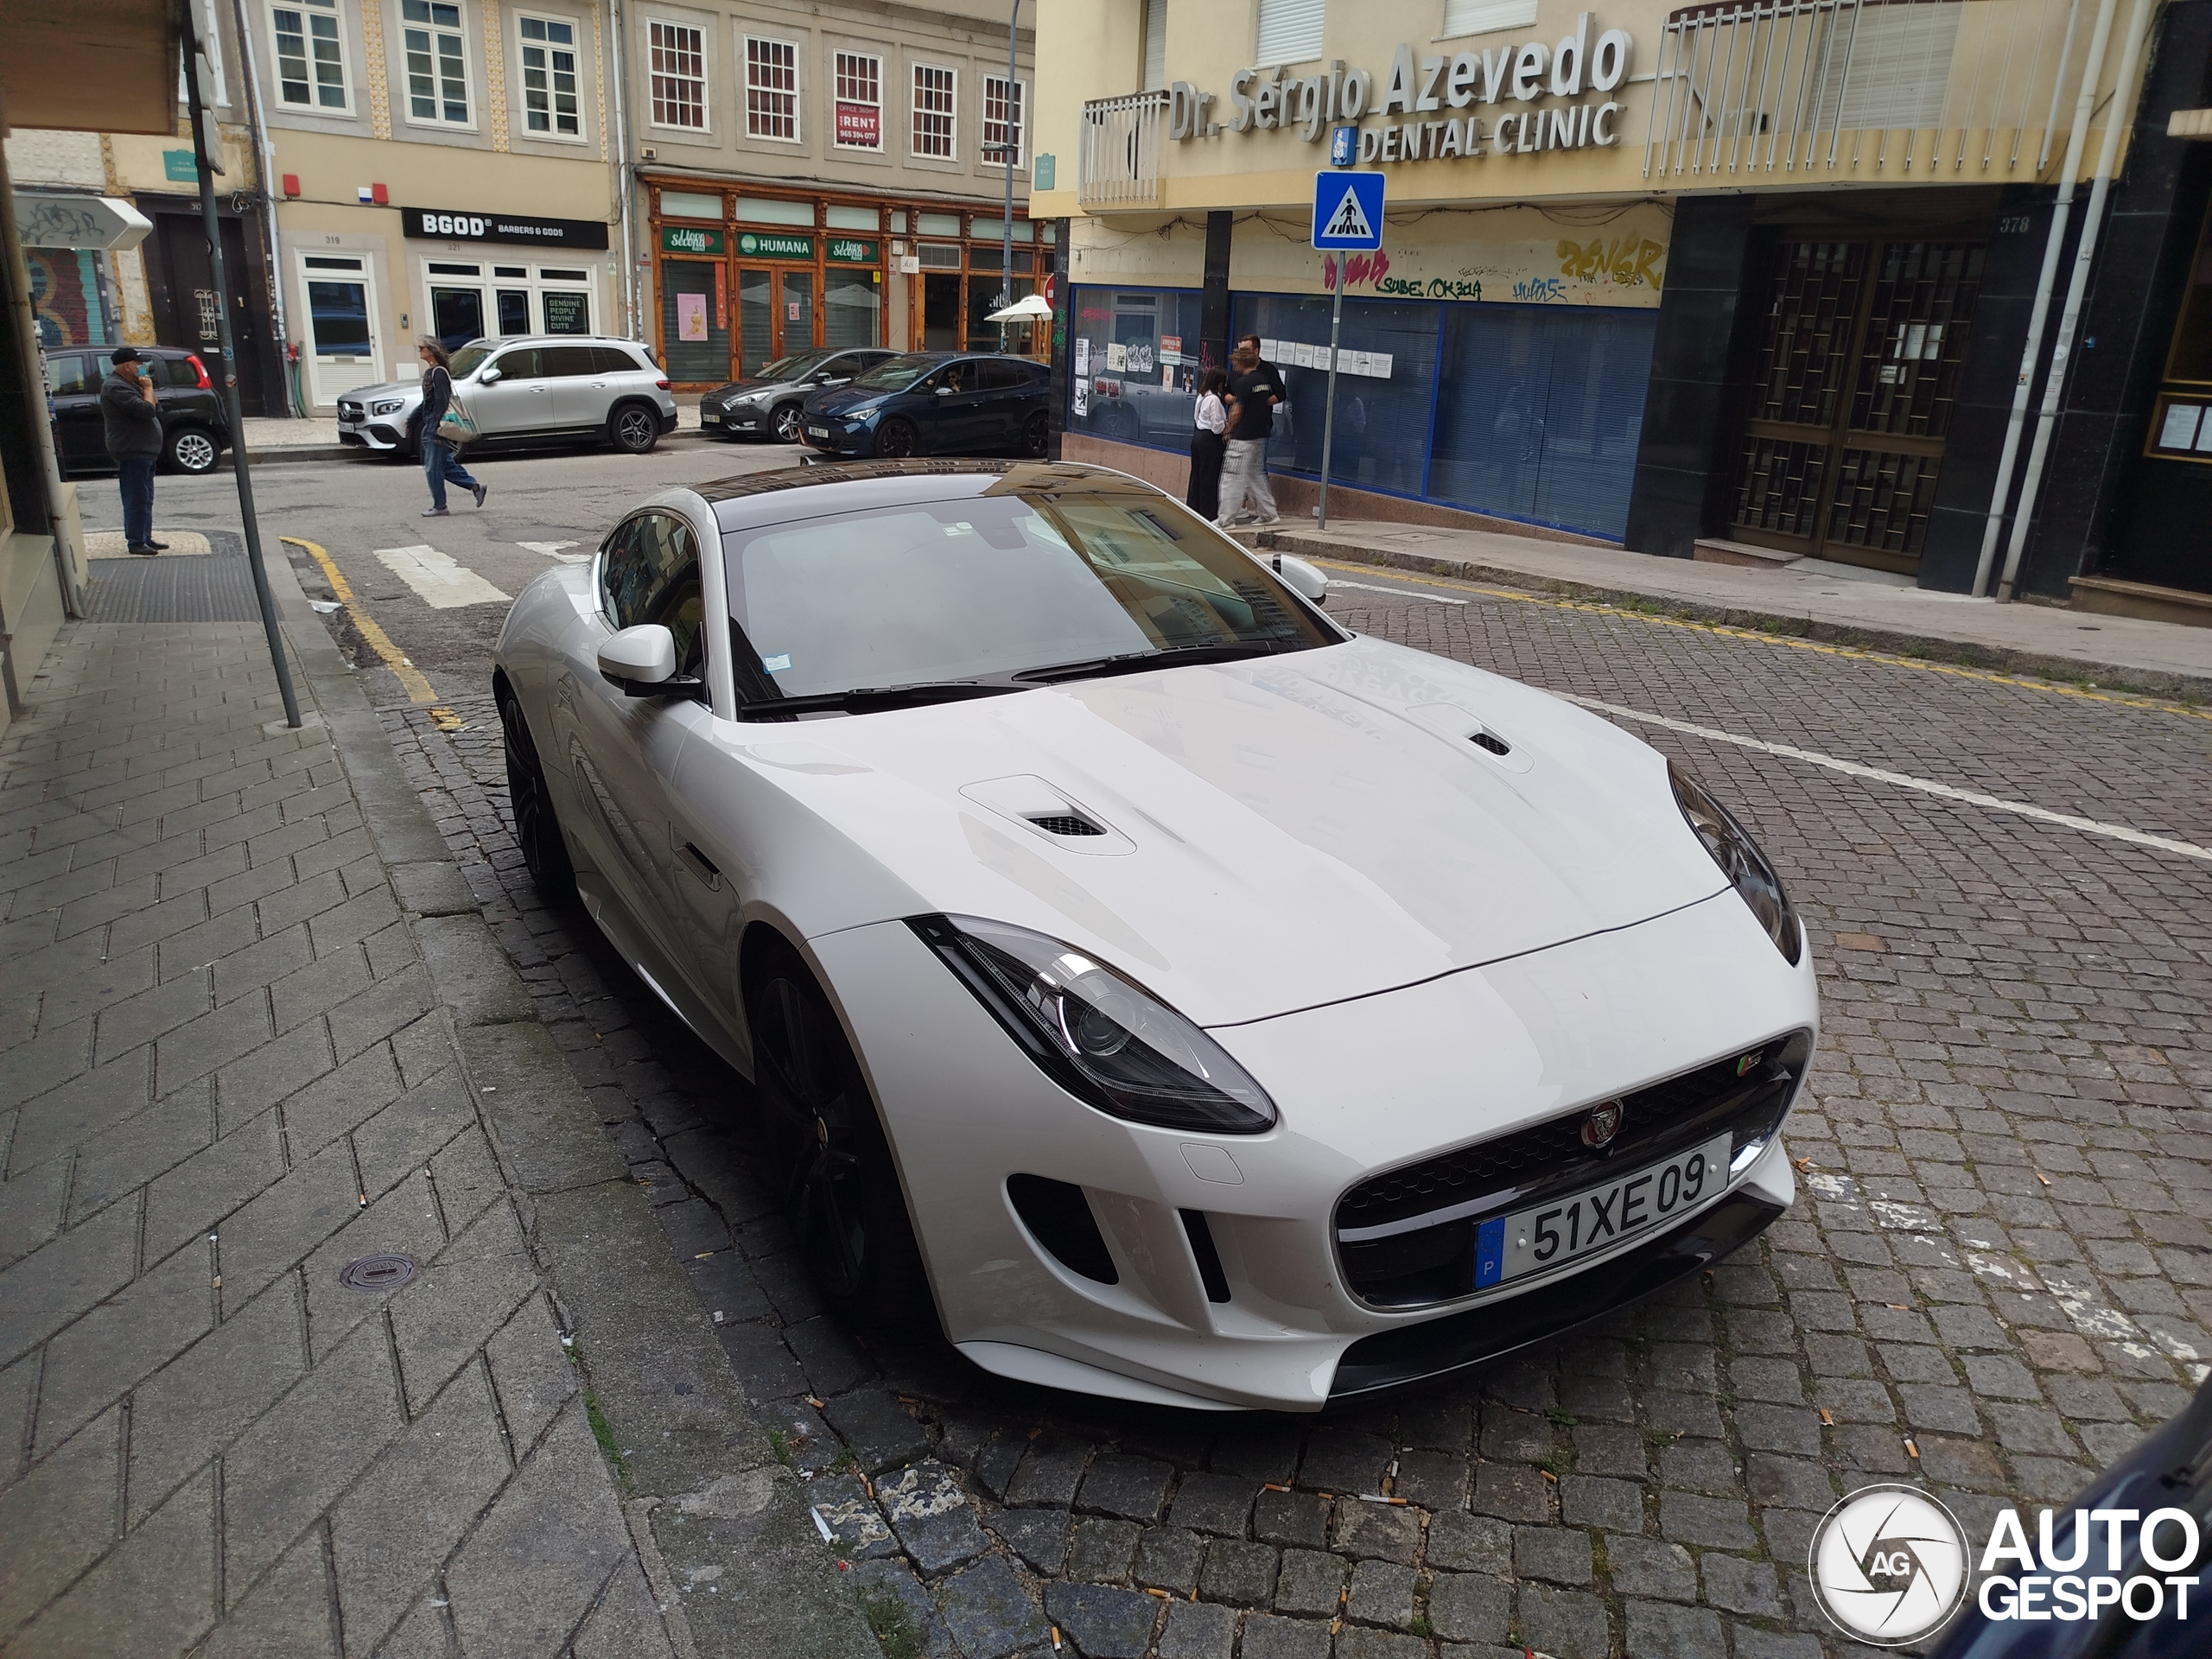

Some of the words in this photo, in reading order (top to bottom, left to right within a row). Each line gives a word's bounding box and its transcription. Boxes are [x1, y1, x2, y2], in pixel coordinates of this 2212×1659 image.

[1169, 79, 1219, 141] Dr.
[1228, 60, 1370, 143] Sérgio
[1380, 12, 1633, 117] Azevedo
[839, 105, 857, 113] OFFICE
[843, 115, 875, 130] RENT
[1358, 117, 1485, 163] DENTAL
[1493, 102, 1627, 154] CLINIC
[422, 213, 485, 237] BGOD
[498, 224, 534, 236] BARBERS
[535, 227, 542, 236] &
[542, 227, 564, 237] GODS
[1999, 216, 2030, 233] 378
[325, 236, 340, 245] 319
[760, 238, 810, 254] HUMANA
[549, 299, 582, 308] GENUINE
[550, 307, 576, 315] PEOPLE
[1484, 1260, 1495, 1275] P
